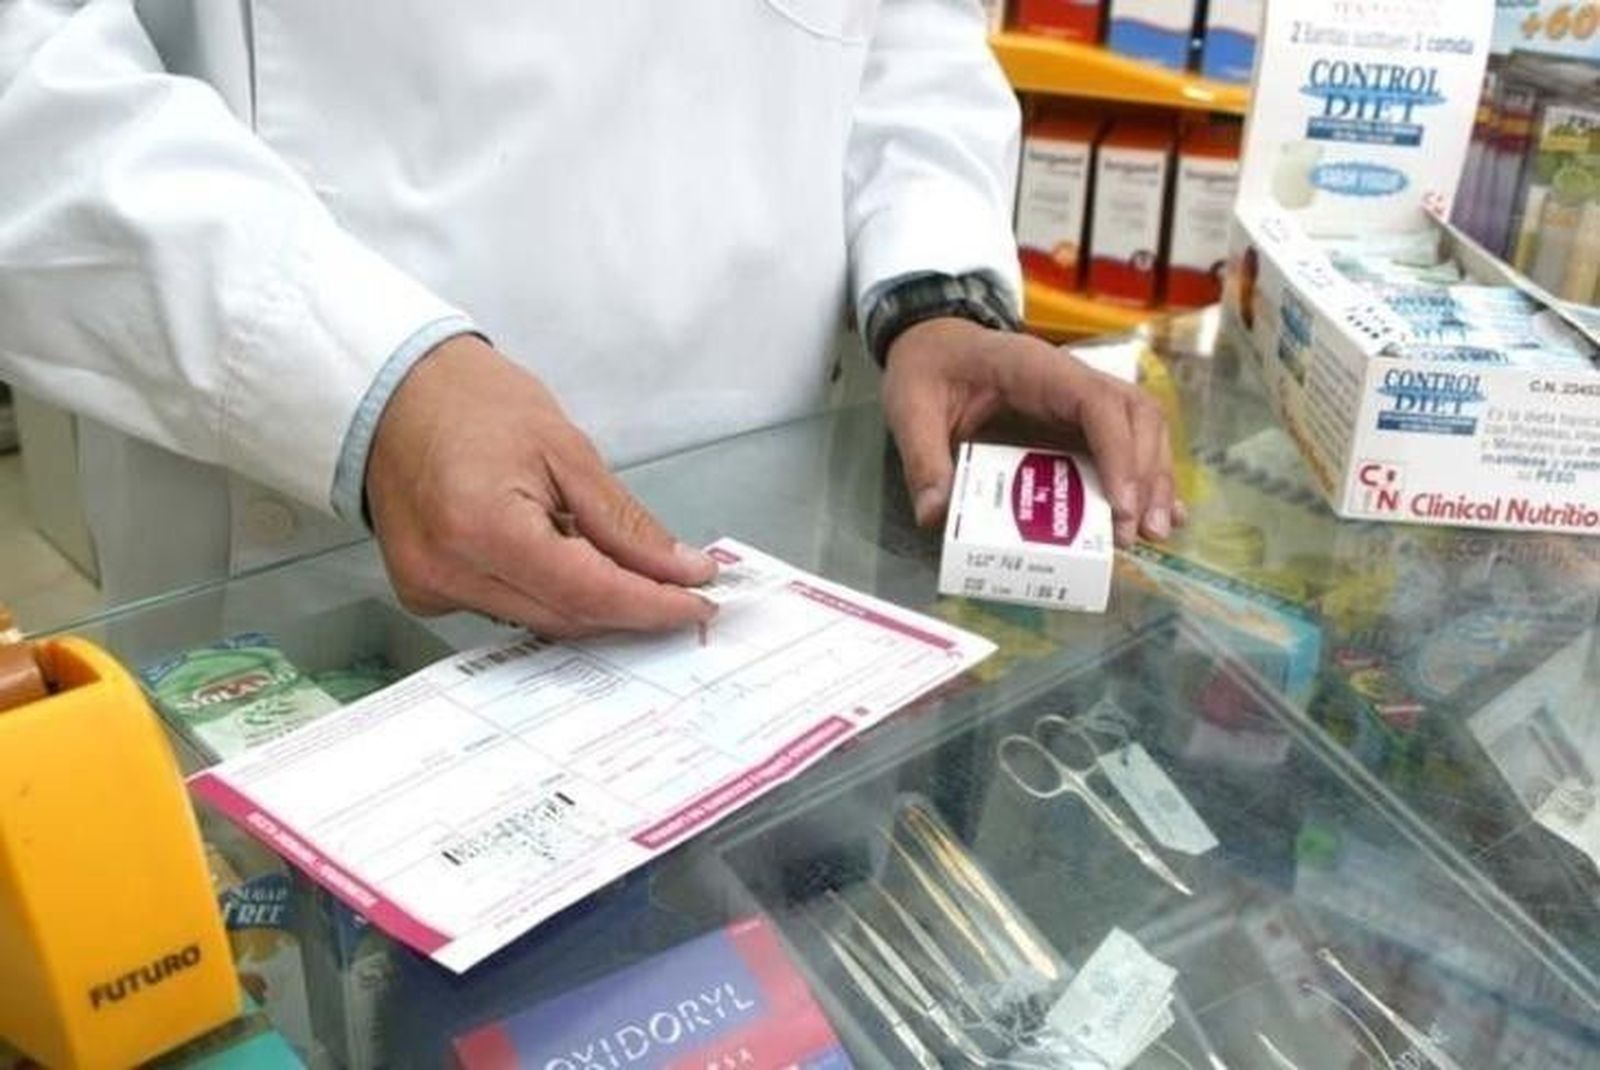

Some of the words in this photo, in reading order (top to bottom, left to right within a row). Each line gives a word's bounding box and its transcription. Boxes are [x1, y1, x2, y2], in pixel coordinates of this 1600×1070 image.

[1308, 58, 1442, 97] CONTROL
[1322, 92, 1418, 123] DIET
[1382, 368, 1488, 400] CONTROL
[1393, 391, 1466, 416] DIET
[1410, 491, 1501, 521] Clinical
[1505, 498, 1599, 528] Nutritio
[88, 945, 201, 1010] FUTURO
